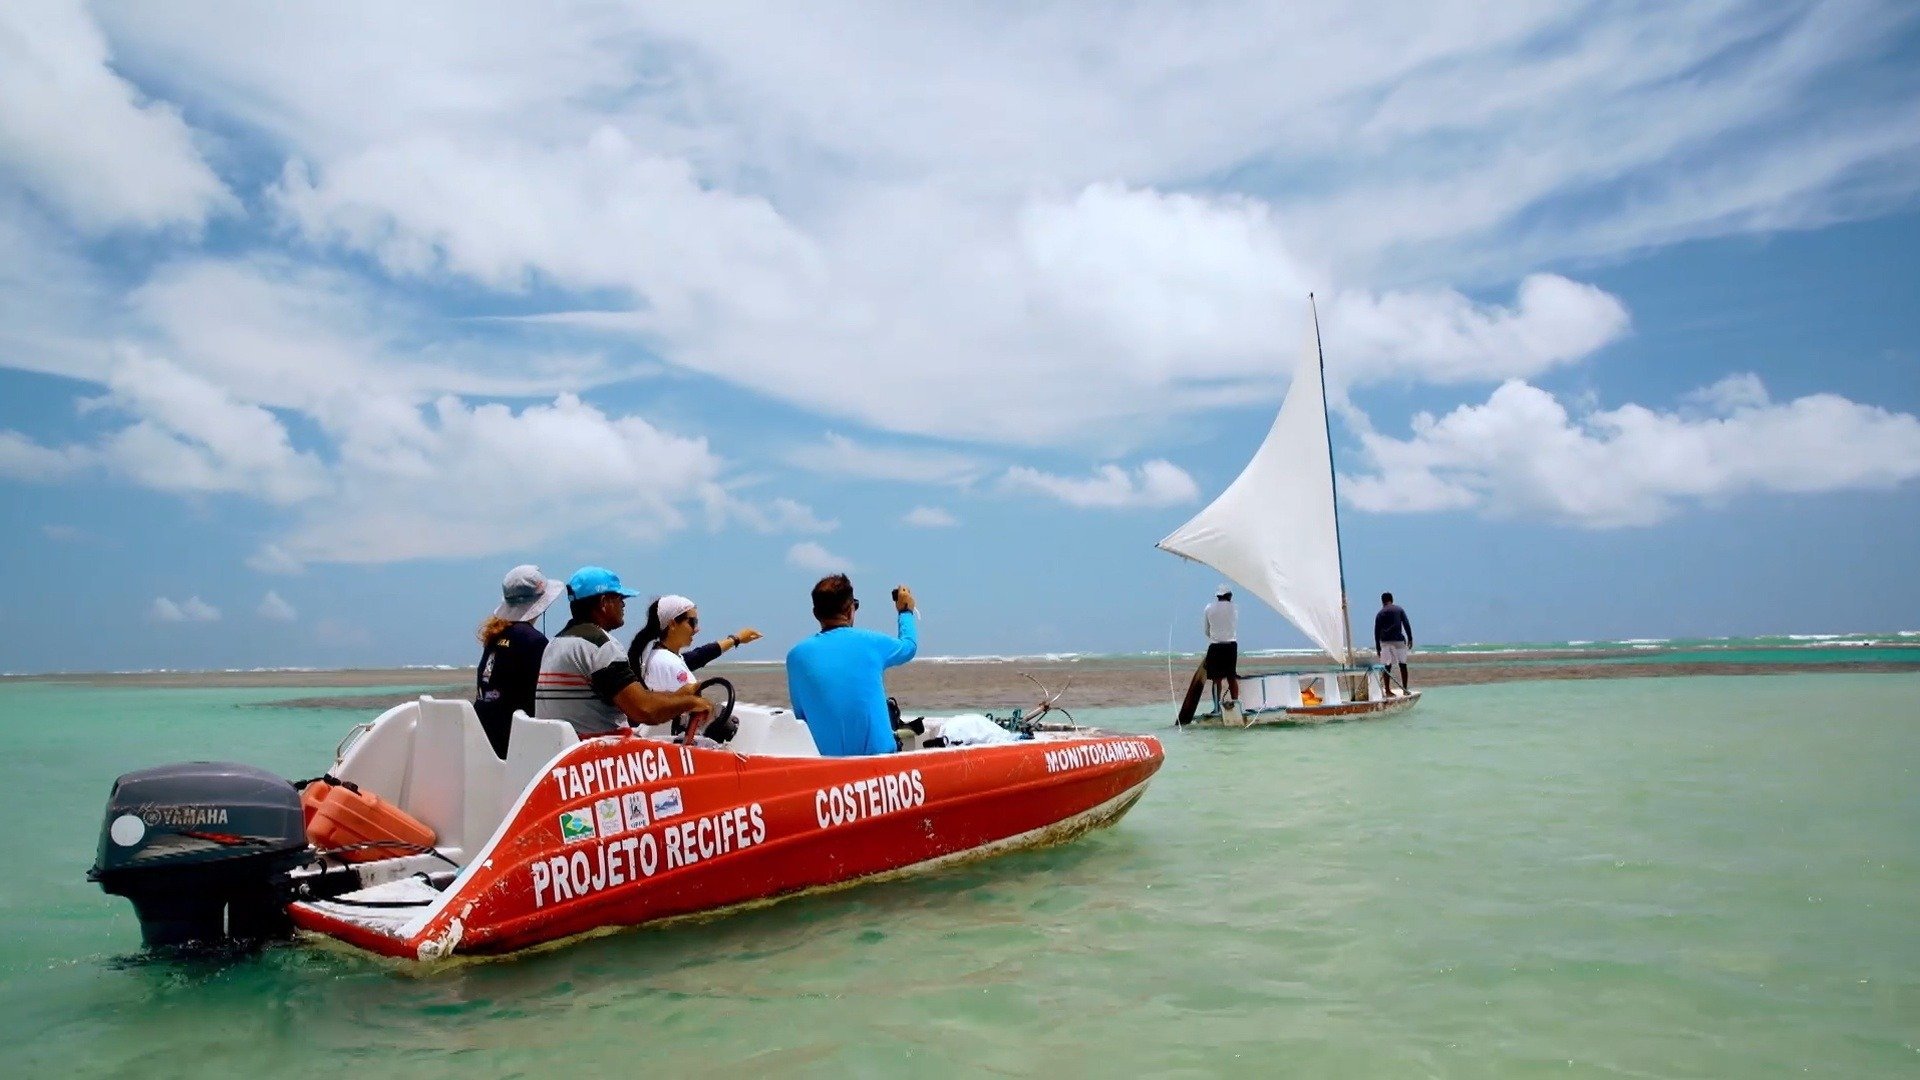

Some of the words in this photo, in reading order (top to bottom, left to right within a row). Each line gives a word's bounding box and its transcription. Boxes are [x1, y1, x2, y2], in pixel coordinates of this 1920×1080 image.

[552, 748, 672, 801] TAPITANGA
[1044, 741, 1150, 772] MONITORAMENTO
[164, 808, 228, 825] YAMAHA
[815, 769, 926, 829] COSTEIROS
[531, 833, 659, 908] PROJETO
[665, 802, 767, 870] RECIFES
